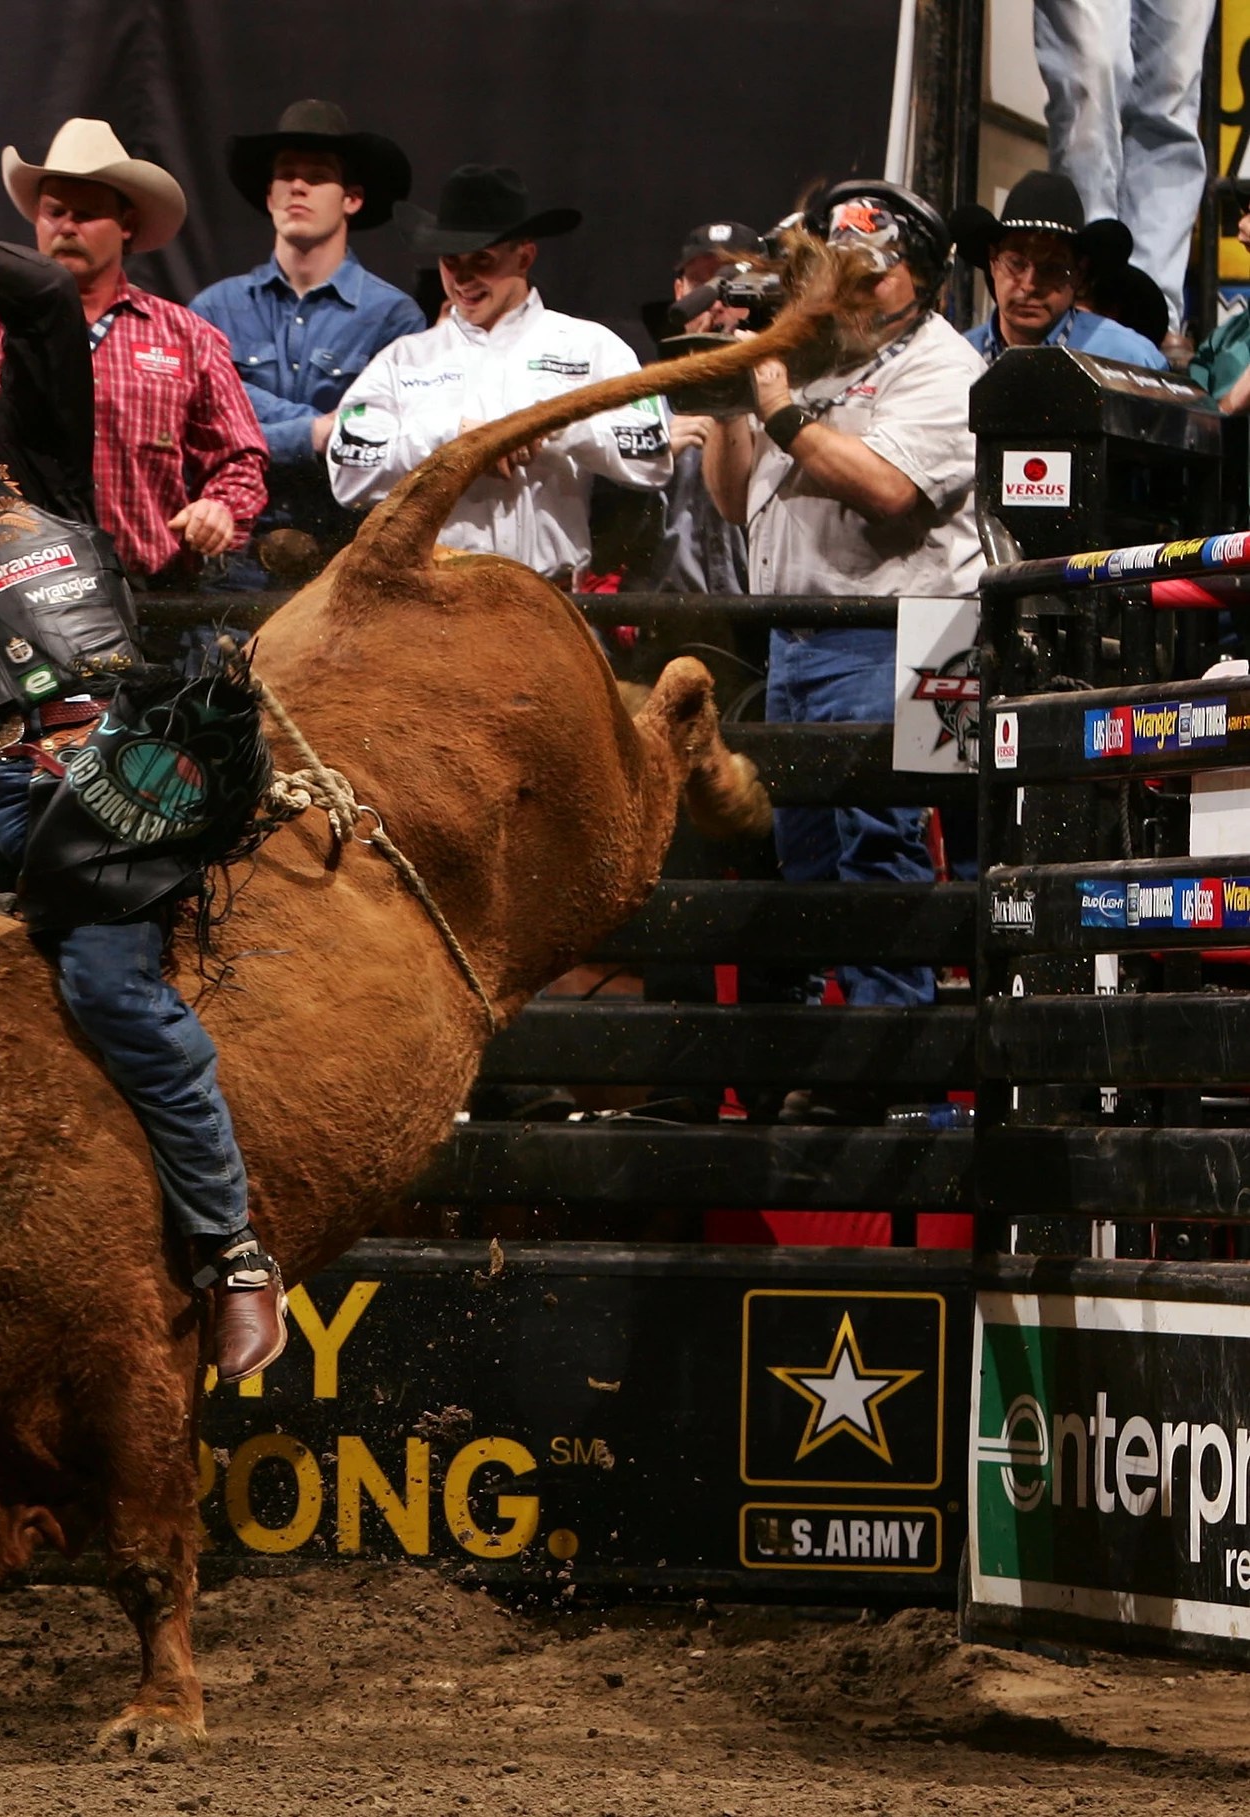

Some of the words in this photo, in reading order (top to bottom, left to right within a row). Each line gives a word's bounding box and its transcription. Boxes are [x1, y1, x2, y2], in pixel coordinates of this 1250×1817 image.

[1006, 484, 1066, 495] VERSUS
[0, 561, 61, 586] TRACTORS
[25, 576, 97, 603] Wrangler
[1093, 719, 1105, 751] LAS
[1132, 706, 1178, 750] Wrangler
[1082, 896, 1099, 908] BUD
[1101, 896, 1125, 909] LIGHT
[1181, 889, 1194, 921] LAS
